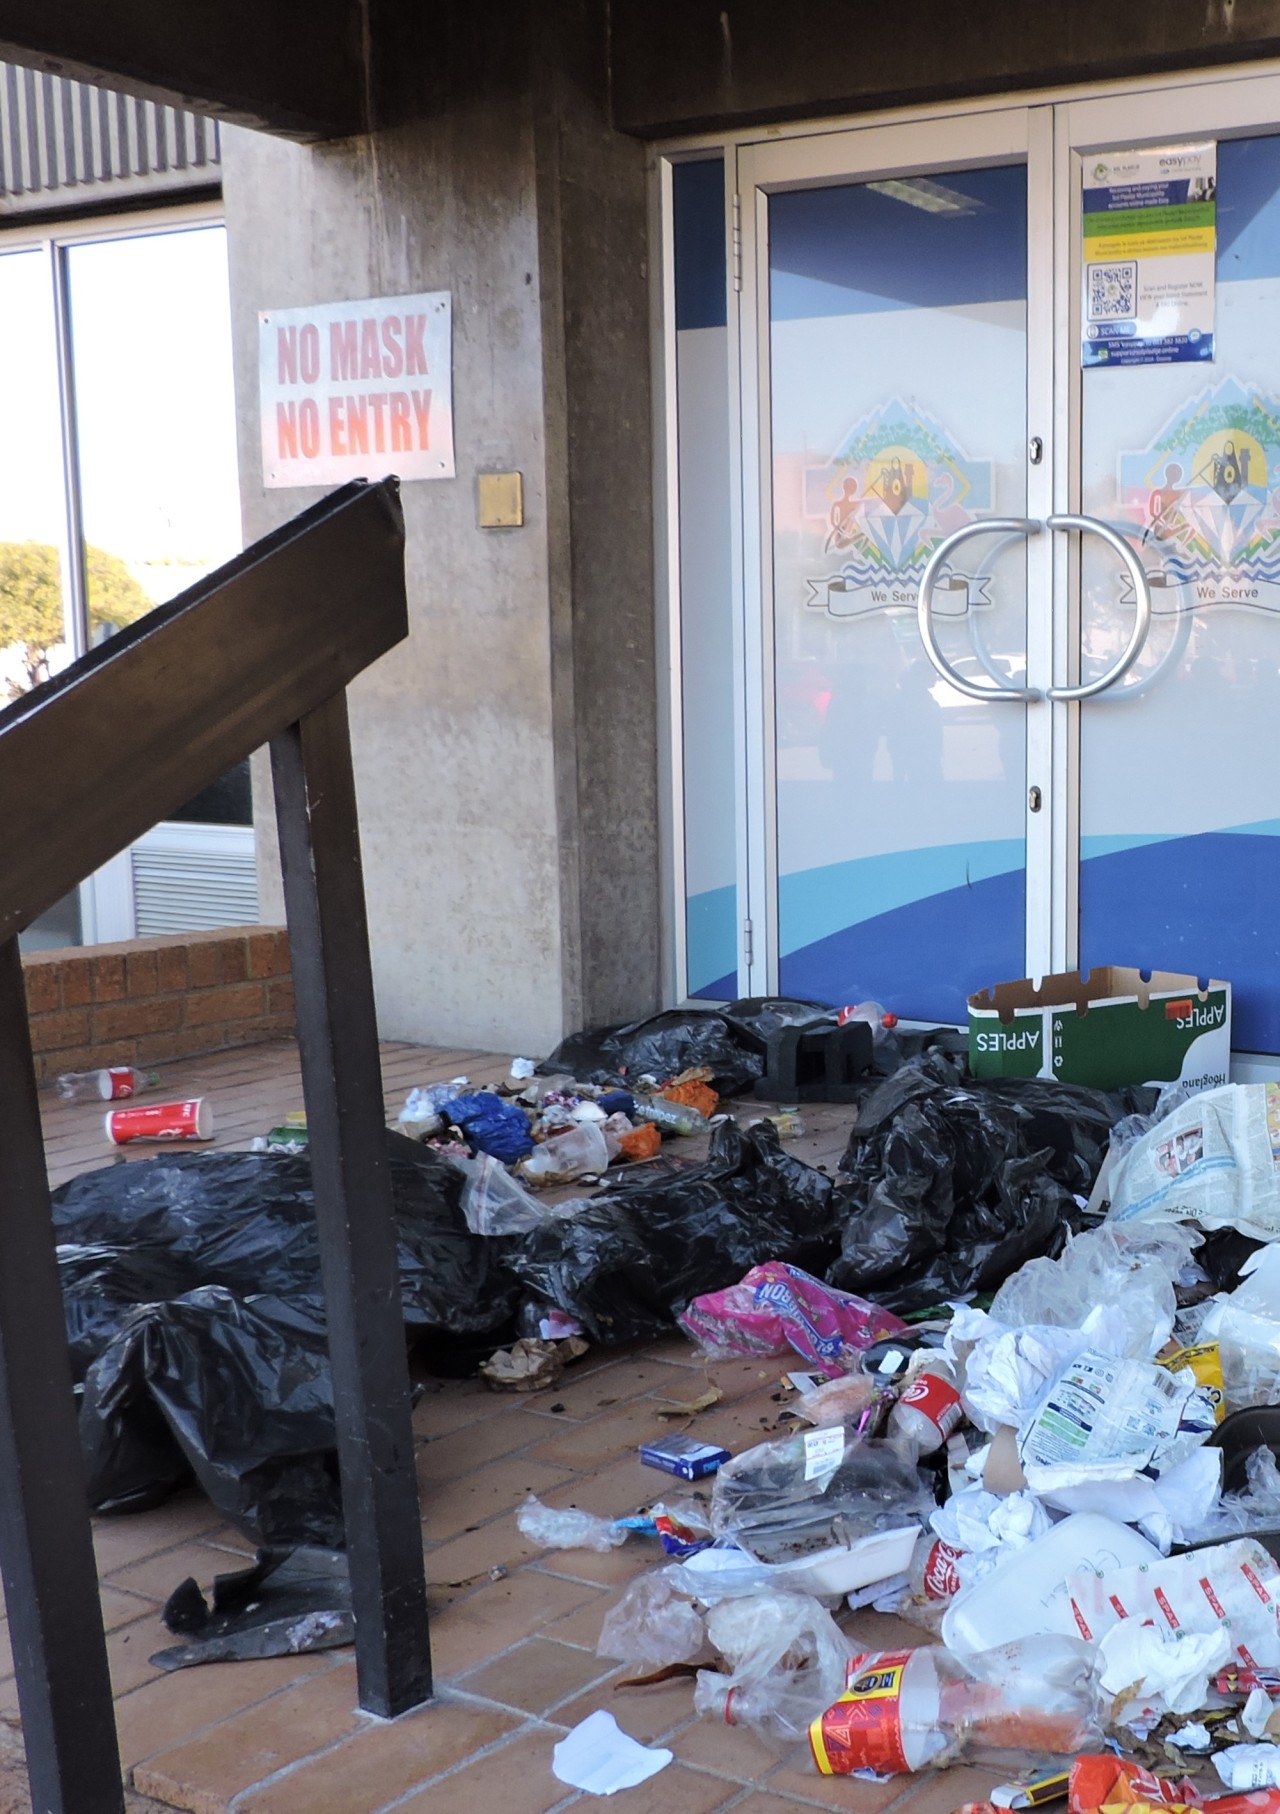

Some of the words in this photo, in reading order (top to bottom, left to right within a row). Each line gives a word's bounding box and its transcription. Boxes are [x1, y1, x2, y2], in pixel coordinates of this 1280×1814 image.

[1159, 155, 1202, 167] easypay
[1100, 327, 1119, 337] SCAN
[277, 323, 321, 385] NO
[329, 314, 429, 382] MASK
[276, 398, 321, 459] NO
[328, 389, 433, 457] ENTRY
[871, 590, 888, 602] We
[892, 590, 919, 602] Serv
[1196, 587, 1216, 599] We
[1222, 587, 1259, 599] Serve
[1176, 1004, 1225, 1030] APPLES
[976, 1030, 1040, 1052] APPLES
[1247, 1572, 1270, 1604] SPAR
[1158, 1596, 1179, 1628] SPAR
[1204, 1586, 1225, 1618] SPAR
